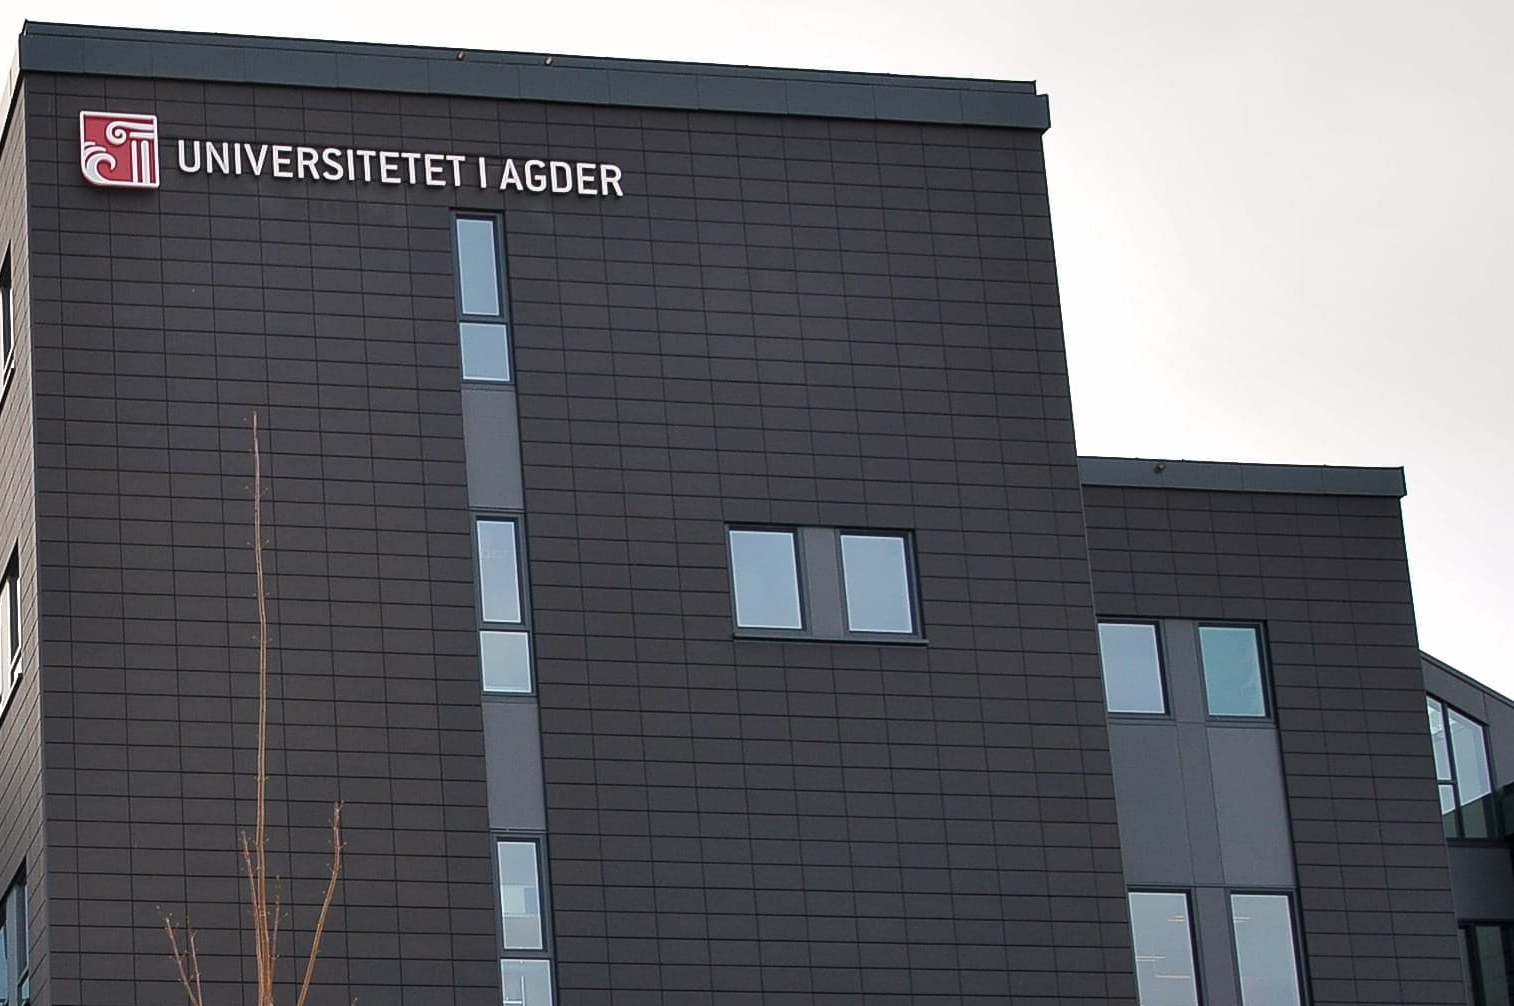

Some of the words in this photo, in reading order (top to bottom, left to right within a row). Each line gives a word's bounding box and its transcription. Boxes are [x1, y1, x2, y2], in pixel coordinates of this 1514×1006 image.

[177, 139, 466, 188] UNIVERSITETET
[478, 156, 487, 189] I
[499, 158, 624, 197] AGDER
